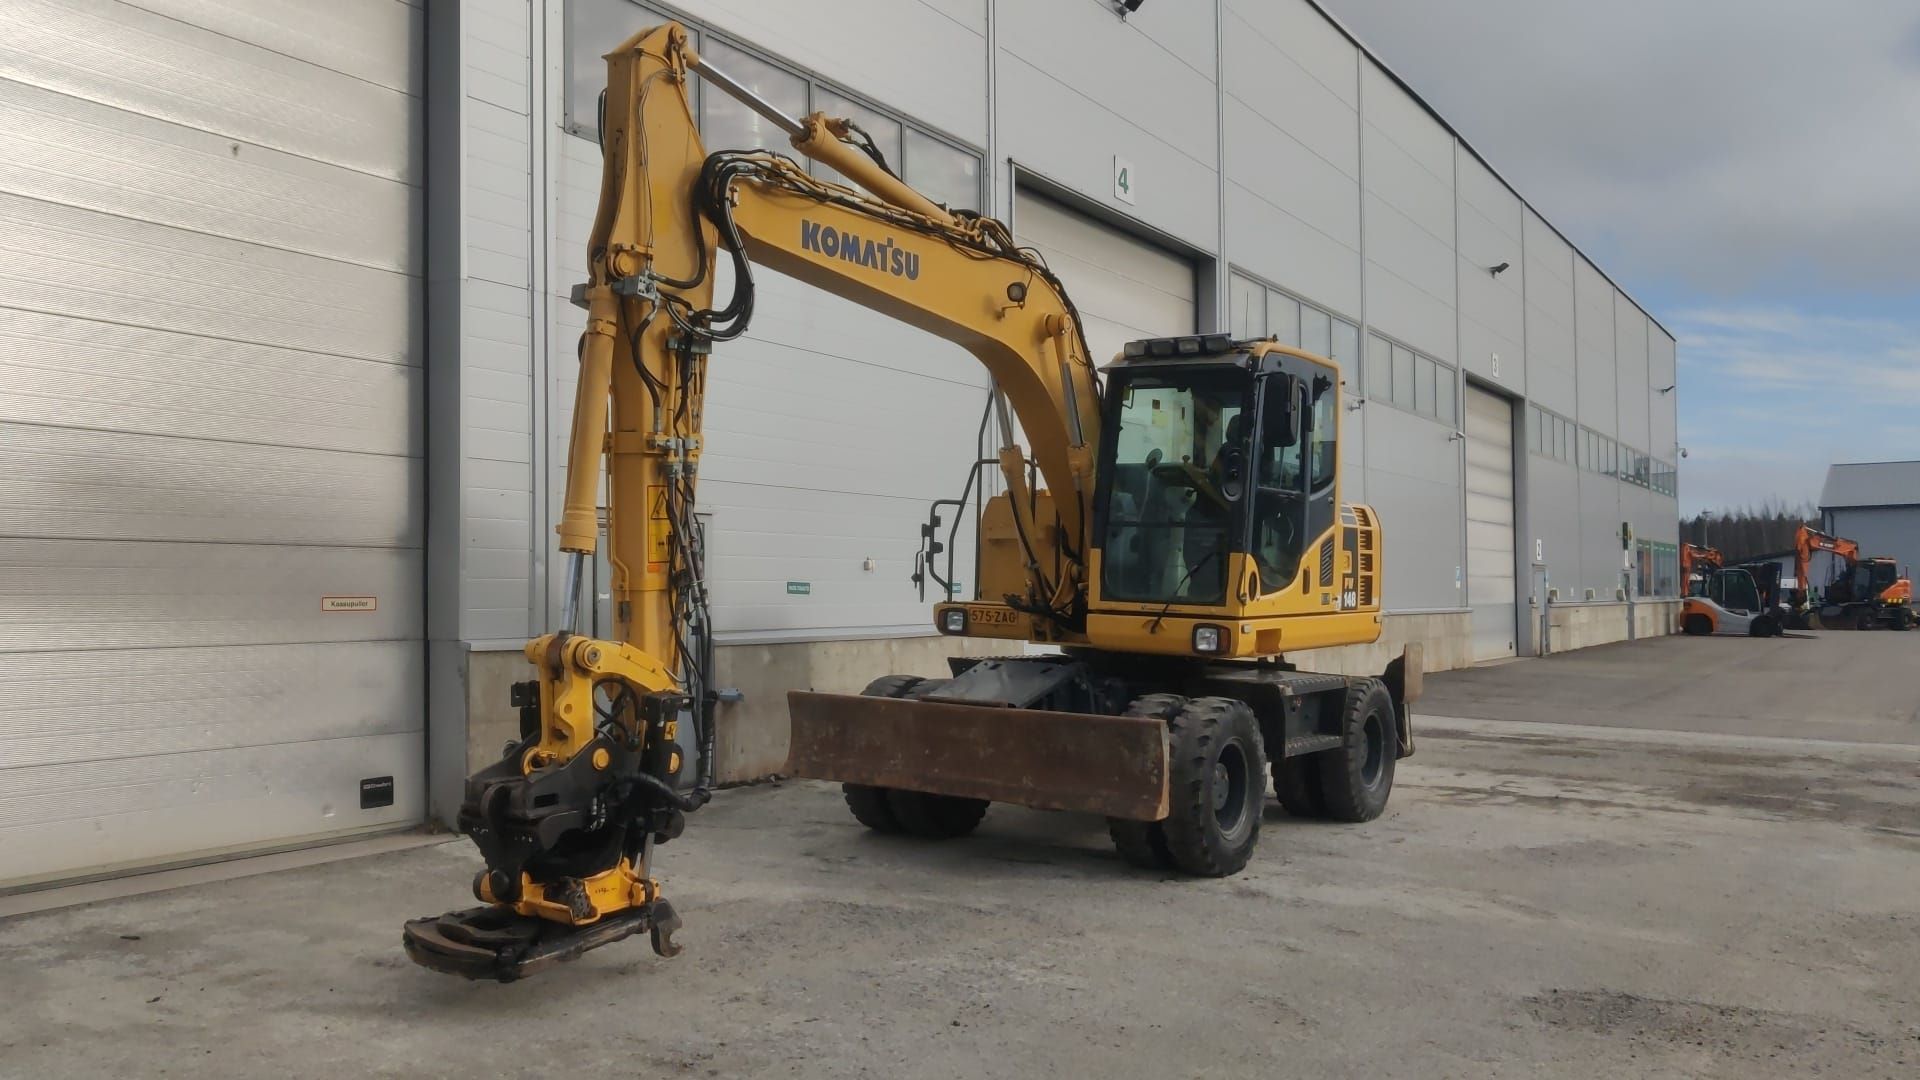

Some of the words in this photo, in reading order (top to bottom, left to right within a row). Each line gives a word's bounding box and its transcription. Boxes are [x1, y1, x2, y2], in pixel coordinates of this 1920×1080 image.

[1118, 167, 1129, 194] 4
[801, 218, 919, 281] KOMATSU
[1343, 591, 1357, 608] 148
